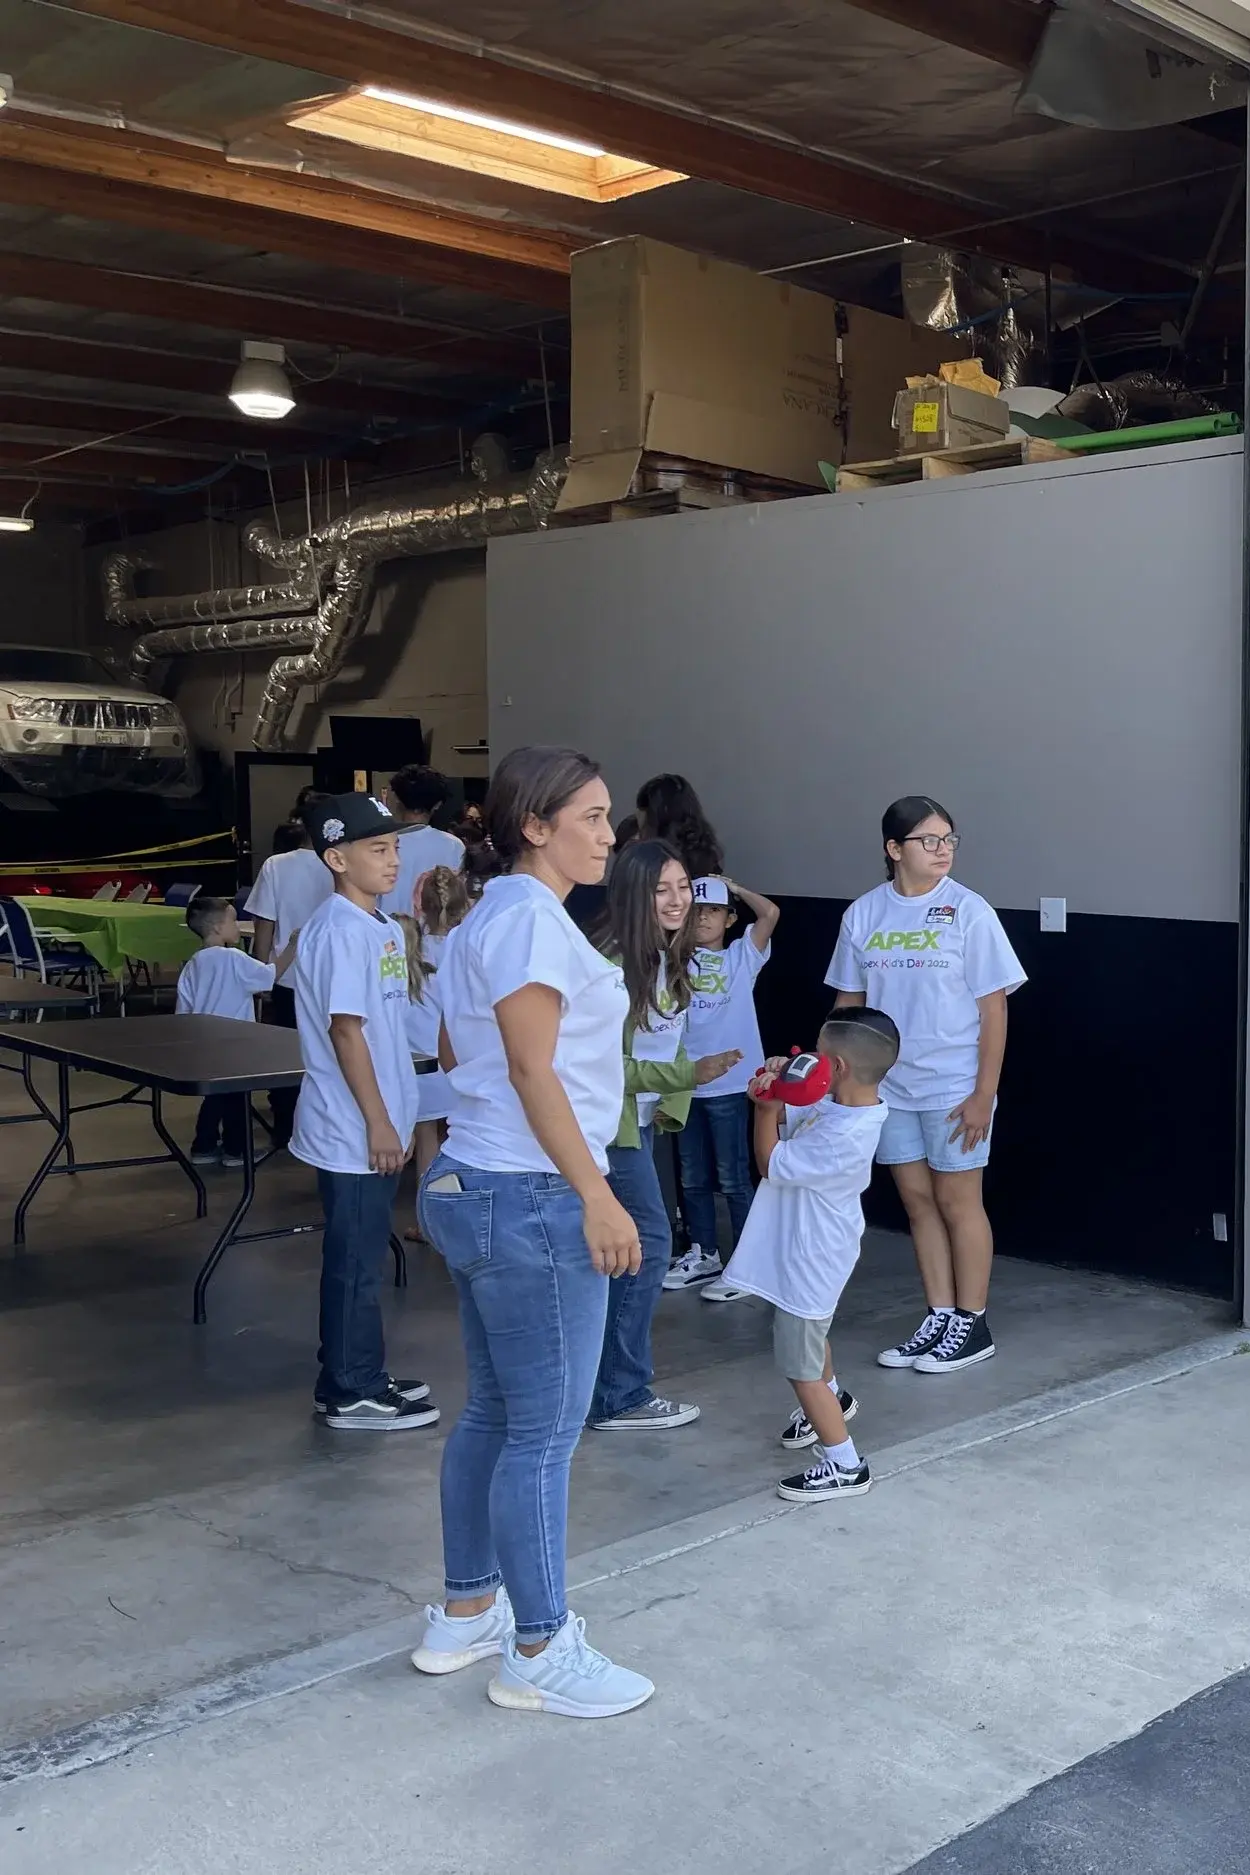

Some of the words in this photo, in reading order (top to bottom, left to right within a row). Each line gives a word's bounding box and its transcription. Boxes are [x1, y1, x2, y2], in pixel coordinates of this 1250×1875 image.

[864, 929, 943, 952] APEX
[906, 958, 926, 969] Day
[927, 959, 950, 969] 2022
[690, 973, 728, 994] EX
[698, 1000, 716, 1009] Day
[654, 1023, 670, 1033] pex
